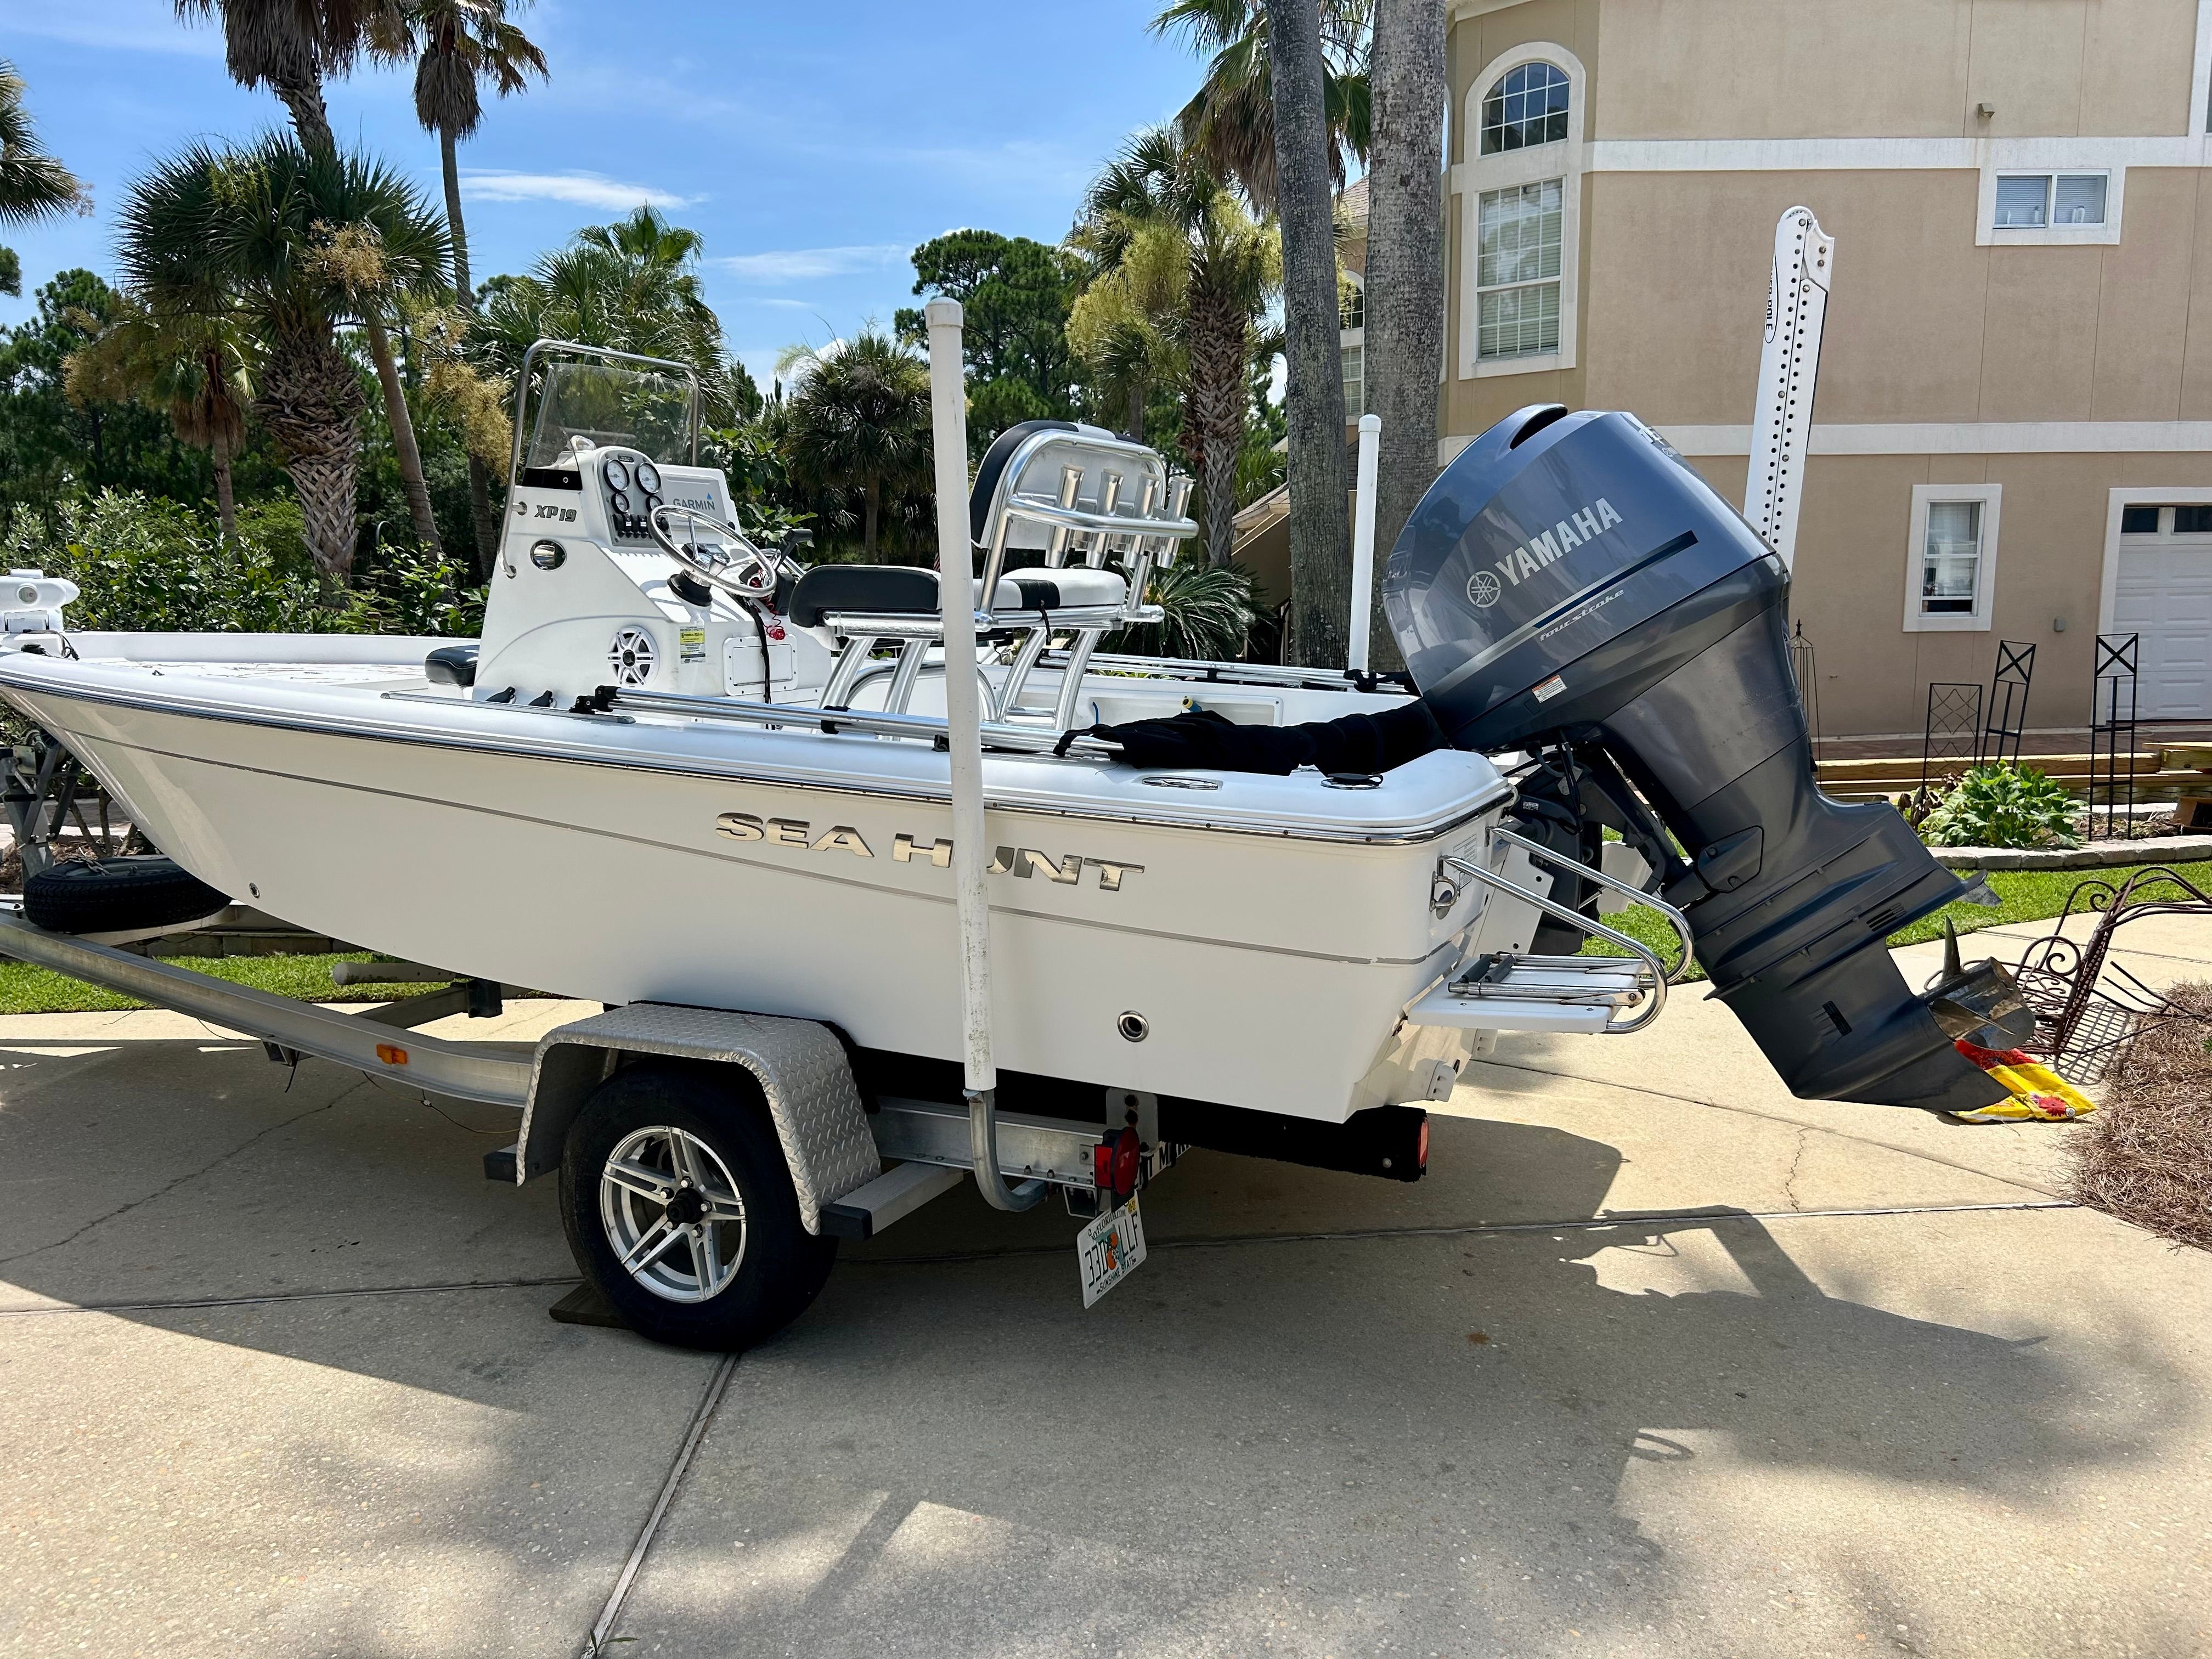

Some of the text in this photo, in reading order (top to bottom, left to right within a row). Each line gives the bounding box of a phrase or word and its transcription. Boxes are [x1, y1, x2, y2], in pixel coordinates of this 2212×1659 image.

[673, 498, 715, 511] GARMIN
[1495, 498, 1623, 586] YAMAHA
[715, 812, 875, 857] SEA
[1099, 1255, 1135, 1292] SUNSHINE STATE
